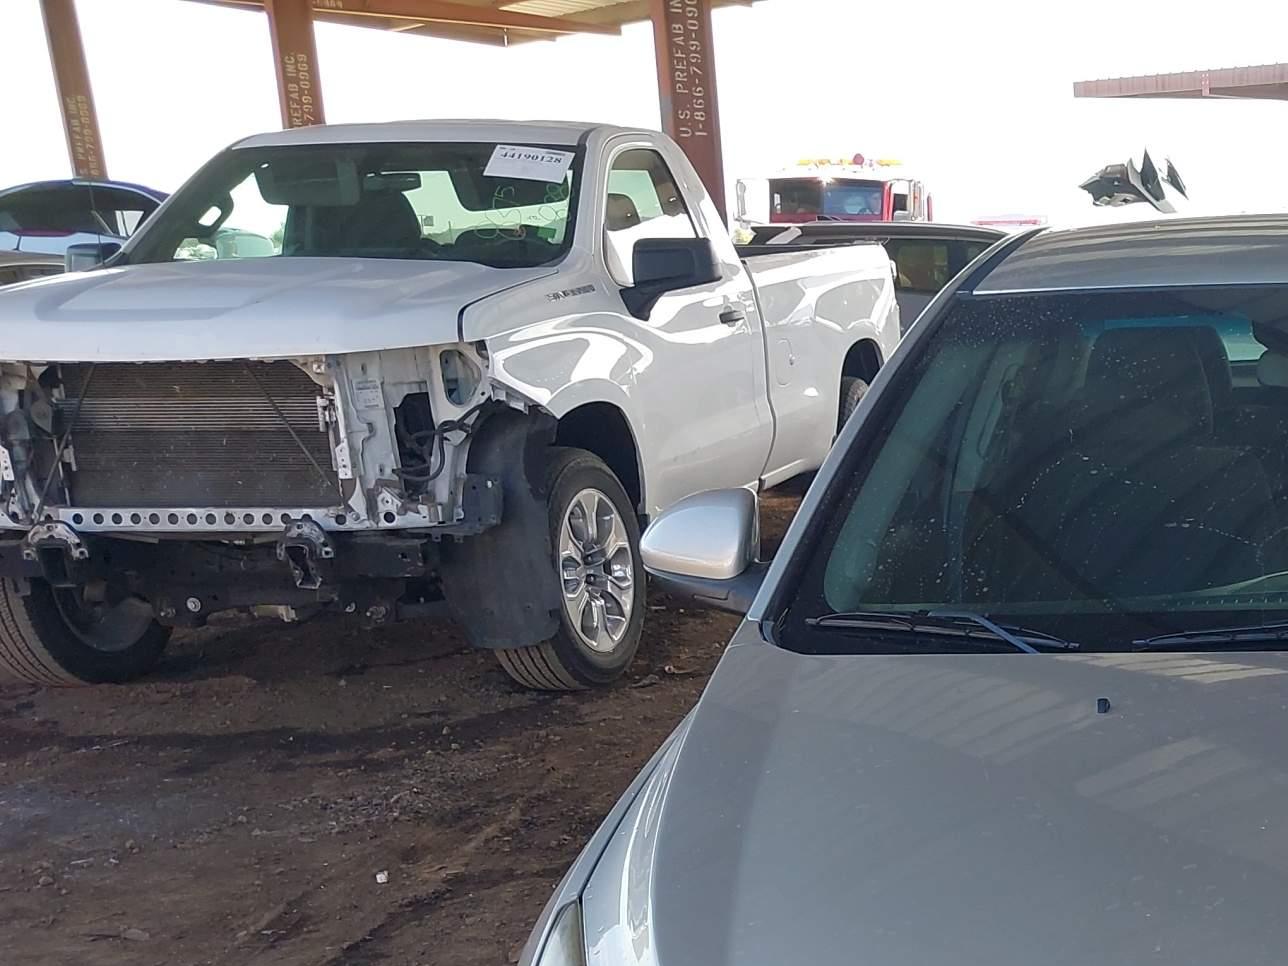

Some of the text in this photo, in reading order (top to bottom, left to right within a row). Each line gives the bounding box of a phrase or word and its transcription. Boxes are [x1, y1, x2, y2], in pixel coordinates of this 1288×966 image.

[672, 23, 689, 93] PREFAB
[288, 83, 303, 127] REFAB
[679, 105, 693, 137] U.S.
[500, 151, 562, 164] 44190128
